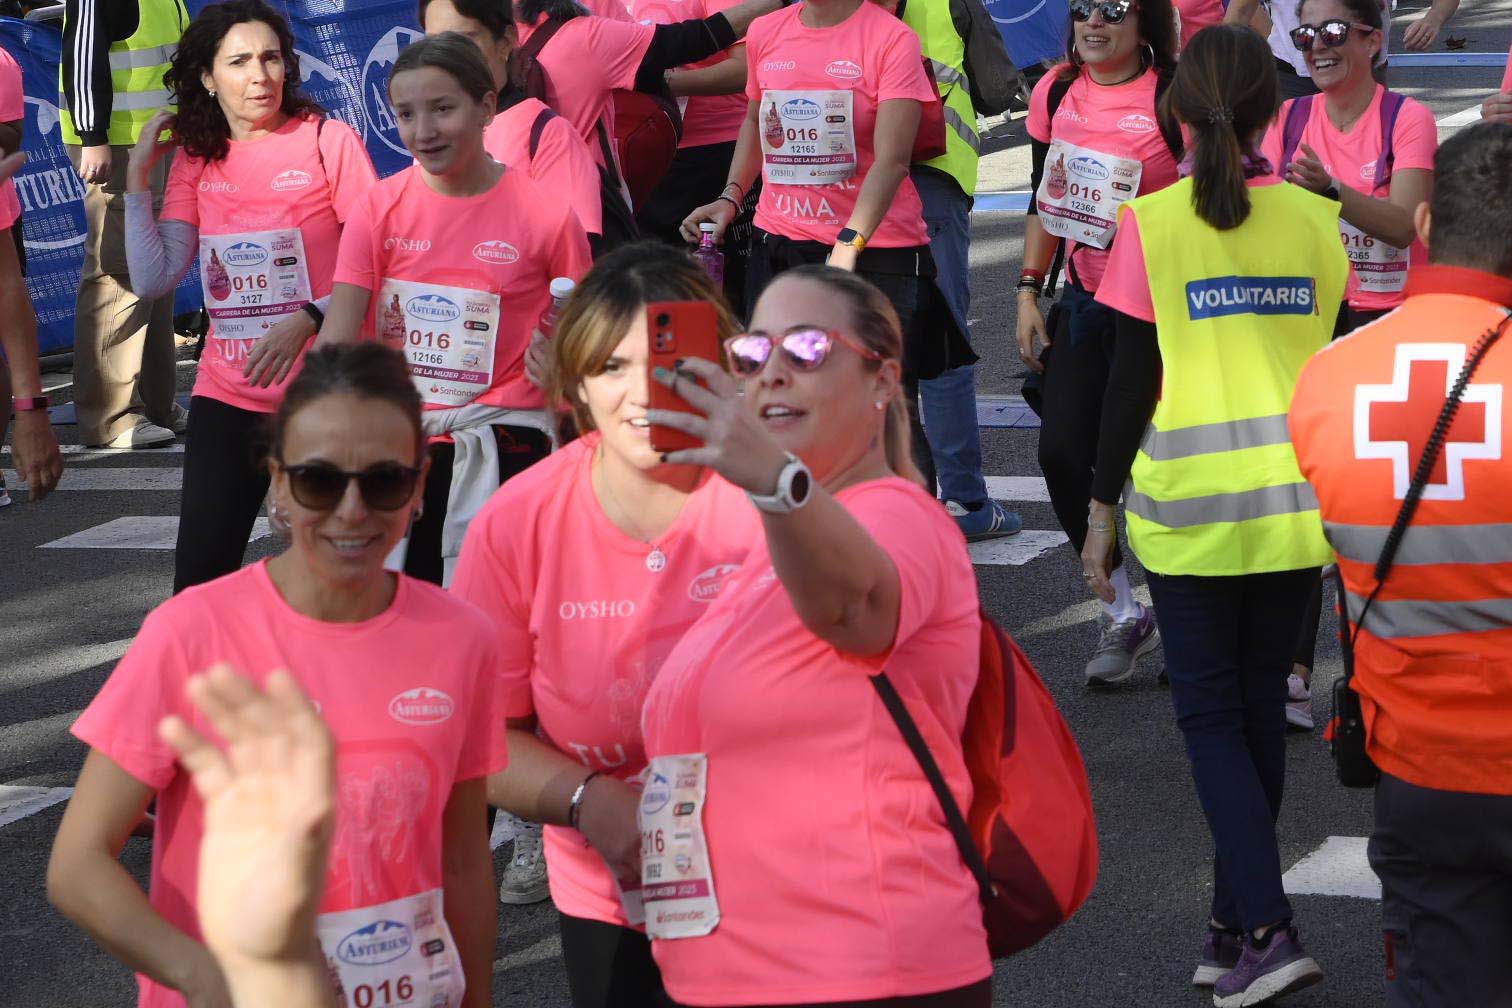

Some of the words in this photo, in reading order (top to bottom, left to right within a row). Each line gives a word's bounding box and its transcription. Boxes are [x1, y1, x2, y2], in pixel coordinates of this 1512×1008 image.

[763, 60, 795, 72] OYSHO
[828, 67, 860, 77] ASTURIANA
[783, 108, 818, 116] ASTURIANA
[787, 129, 818, 141] 016
[791, 146, 816, 154] 12165
[1071, 161, 1106, 176] ASTURIANA
[1070, 183, 1102, 201] 016
[1071, 200, 1096, 213] 12366
[1088, 216, 1106, 226] MUJER
[385, 238, 431, 252] OYSHO
[1341, 233, 1374, 247] 016
[271, 243, 294, 251] SUMA
[226, 251, 264, 262] ASTURIANA
[477, 248, 515, 260] ASTURIANA
[233, 275, 267, 290] 016
[241, 294, 262, 304] 3127
[1190, 278, 1312, 311] VOLUNTARIS
[216, 308, 241, 317] CARRERA
[251, 307, 260, 315] LA
[261, 306, 283, 314] MUJER
[410, 304, 456, 318] ASTURIANA
[466, 306, 490, 314] SUMA
[410, 330, 450, 349] 016
[413, 352, 443, 364] 12166
[424, 368, 433, 376] LA
[434, 370, 459, 378] MUJER
[559, 600, 635, 620] OYSHO
[568, 741, 626, 768] TU
[353, 975, 413, 1008] 016
